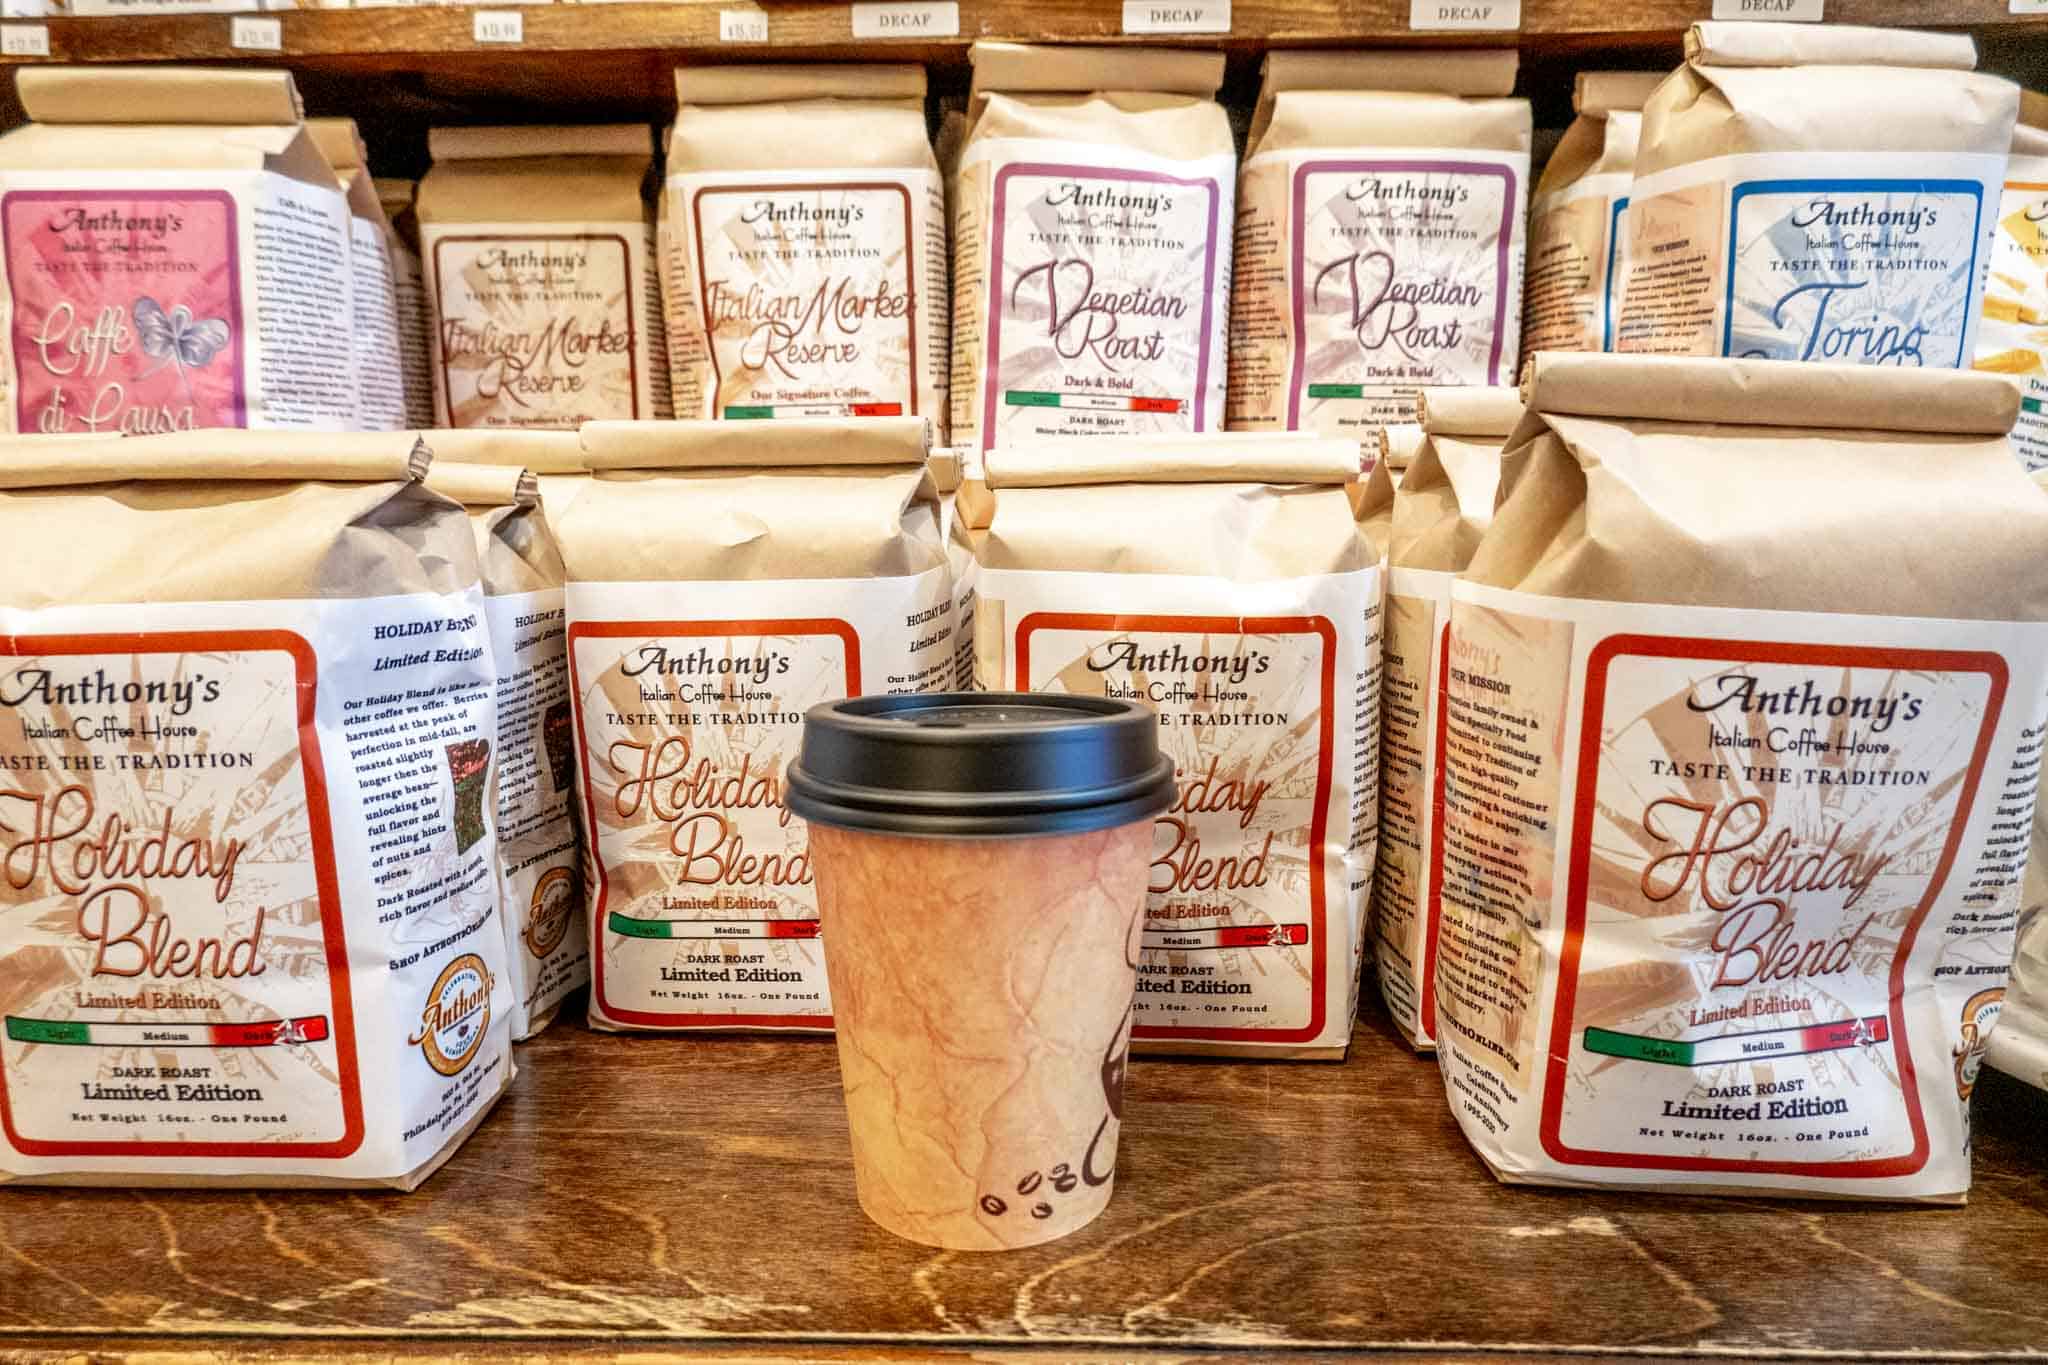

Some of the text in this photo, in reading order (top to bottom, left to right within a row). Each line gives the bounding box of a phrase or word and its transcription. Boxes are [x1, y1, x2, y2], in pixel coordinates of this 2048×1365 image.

[1151, 9, 1203, 24] DECAF
[1438, 7, 1493, 21] DECAF
[1741, 0, 1796, 12] DECAF
[880, 14, 931, 27] DECAF
[1045, 183, 1173, 218] Anthony's
[1345, 178, 1469, 211] Anthony's
[49, 207, 184, 241] Anthony's
[741, 199, 864, 229] Anthony's
[1791, 200, 1938, 235] Anthony's
[1029, 233, 1185, 250] TASTE THE TRADITION
[1330, 227, 1478, 240] TASTE THE TRADITION
[1806, 232, 1920, 254] Italian Coffee House
[476, 248, 588, 274] Anthony's
[729, 247, 881, 261] TASTE THE TRADITION
[1770, 258, 1949, 272] TASTE THE TRADITION
[1011, 259, 1188, 338] Venetian
[1314, 250, 1482, 330] Venetian
[705, 275, 917, 337] Italian Market
[1357, 300, 1464, 362] Roast
[1772, 280, 1931, 362] Torino
[442, 315, 637, 370] Italian Market
[741, 320, 860, 381] Reserve
[1055, 306, 1166, 373] Roast
[477, 353, 588, 409] Reserve
[1064, 375, 1134, 390] Dark & Bold
[1367, 365, 1434, 378] Dark Bold
[776, 388, 831, 402] Signature
[834, 387, 871, 399] Coffee
[906, 605, 939, 627] HOLIDAY
[373, 618, 444, 640] HOLIDAY
[373, 650, 429, 672] Limited
[620, 646, 790, 684] Anthony's
[1086, 640, 1270, 684] Anthony's
[0, 668, 221, 716] Anthony's
[639, 683, 772, 705] Italian Coffee House
[1104, 680, 1248, 704] Italian Coffee House
[1468, 673, 1512, 696] MISSION
[343, 687, 436, 711] Our Holiday Blend
[1686, 673, 1924, 733] Anthony's
[343, 711, 372, 727] other
[374, 706, 404, 721] coffee
[605, 712, 702, 726] TASTE THE
[1179, 712, 1289, 726] TRADITION
[22, 715, 198, 744] Italian Coffee House
[345, 713, 457, 743] harvested the peak
[350, 739, 404, 760] perfection
[1708, 723, 1890, 756] Italian Coffee House
[58, 752, 257, 771] THE TRADITION
[1649, 758, 1930, 786] TASTE THE TRADITION
[358, 774, 392, 789] longer
[421, 763, 438, 774] the
[362, 788, 403, 805] average
[421, 809, 440, 822] and
[0, 783, 248, 903] Holiday
[386, 843, 432, 863] nuts and
[670, 811, 814, 886] Blend
[1640, 795, 1893, 911] Holiday
[377, 878, 443, 908] Dark Roasted
[662, 895, 777, 911] Limited Edition
[378, 900, 432, 924] rich flavor
[1175, 902, 1231, 919] Edition
[77, 882, 267, 979] Blend
[714, 926, 751, 935] Medium
[1162, 936, 1202, 945] Medium
[1710, 897, 1878, 992] Blend
[687, 954, 765, 964] DARK ROAST
[660, 967, 802, 983] Limited Edition
[1170, 965, 1215, 976] ROAST
[673, 990, 709, 1000] Weight
[759, 992, 781, 1000] One
[785, 991, 820, 1001] Pound
[1181, 978, 1252, 995] Edition
[74, 991, 221, 1011] Limited Edition
[407, 971, 496, 1047] Anthony's
[1204, 1003, 1227, 1013] One
[1231, 1003, 1268, 1013] Pound
[1687, 996, 1813, 1028] Limited Edition
[143, 1031, 190, 1042] Medium
[1741, 1039, 1785, 1054] Medium
[112, 1067, 212, 1079] DARK ROAST
[81, 1083, 264, 1101] Limited Edition
[1707, 1079, 1805, 1099] DARK ROAST
[71, 1112, 94, 1123] Net
[100, 1112, 147, 1124] Weight
[210, 1113, 237, 1123] One
[243, 1112, 288, 1123] Pound
[1661, 1094, 1850, 1122] Limited Edition
[1638, 1125, 1870, 1144] Net Weight 16oz. One Pound
